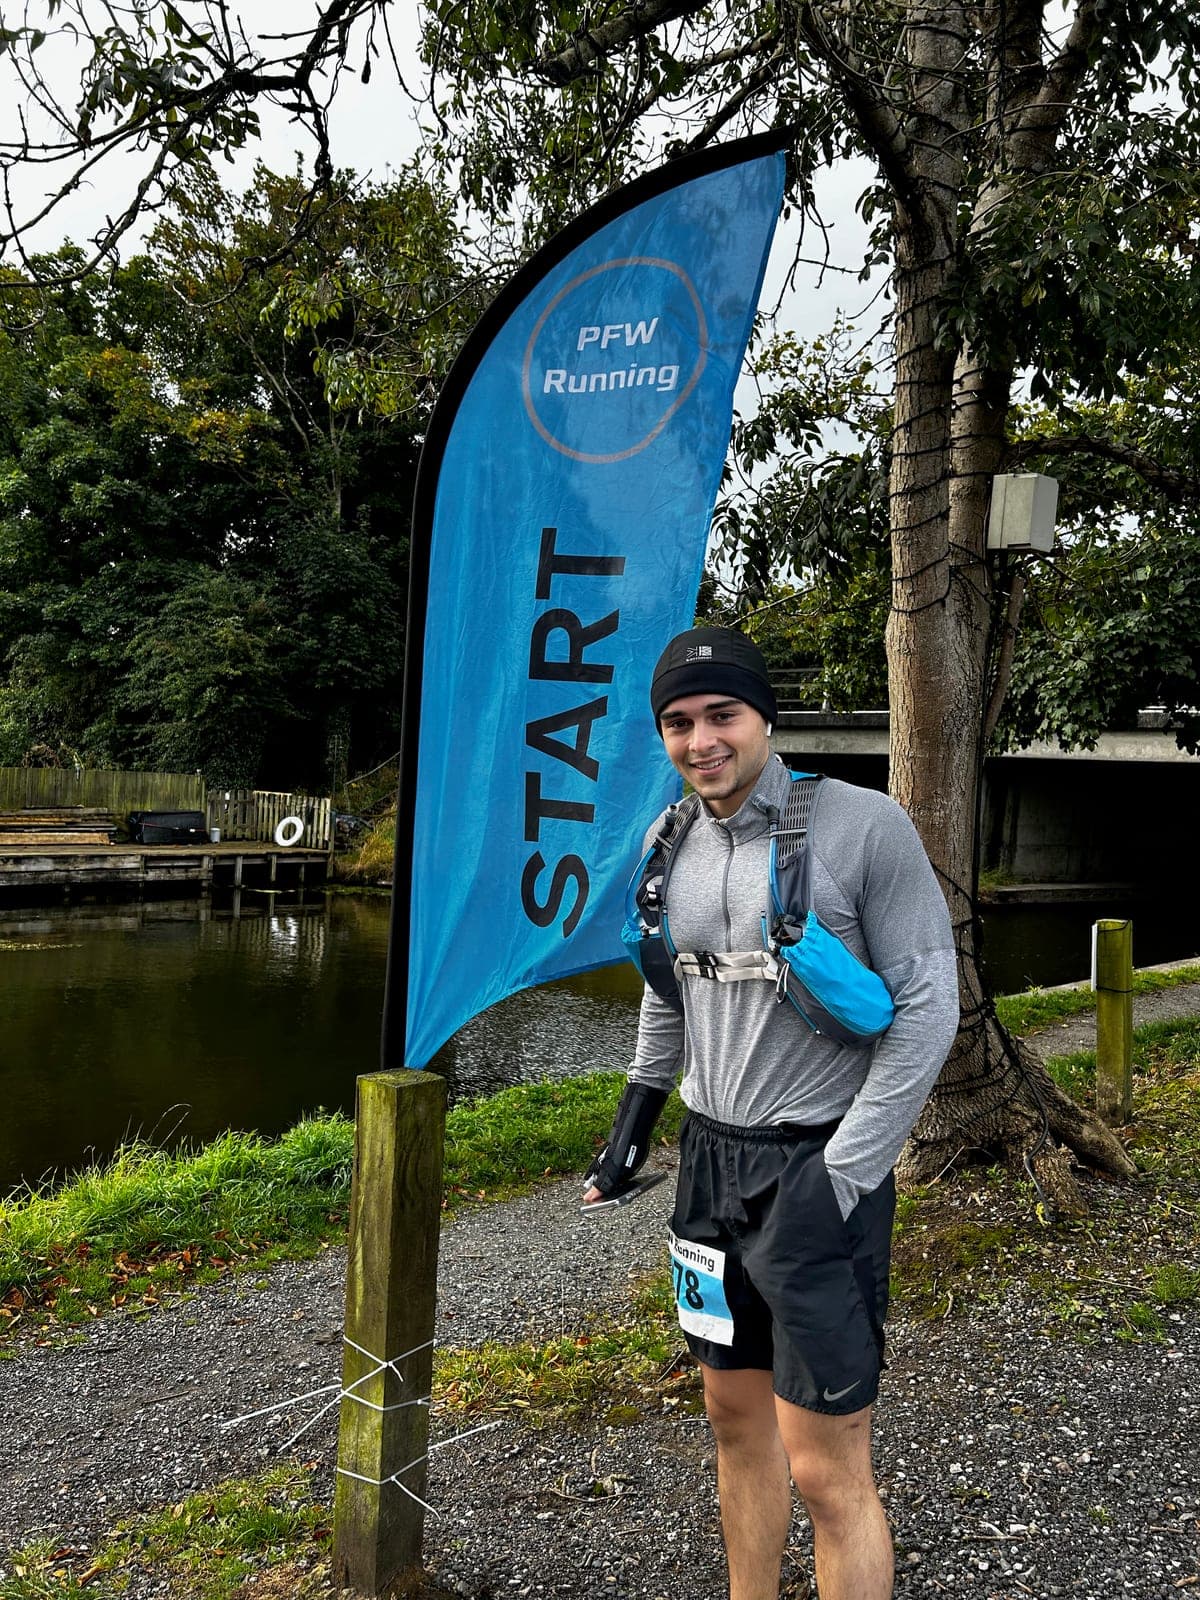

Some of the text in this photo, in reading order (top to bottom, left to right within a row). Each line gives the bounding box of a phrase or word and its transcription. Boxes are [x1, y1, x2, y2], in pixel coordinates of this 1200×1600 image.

[577, 317, 658, 351] PFW
[543, 363, 680, 393] Running
[520, 527, 626, 938] START
